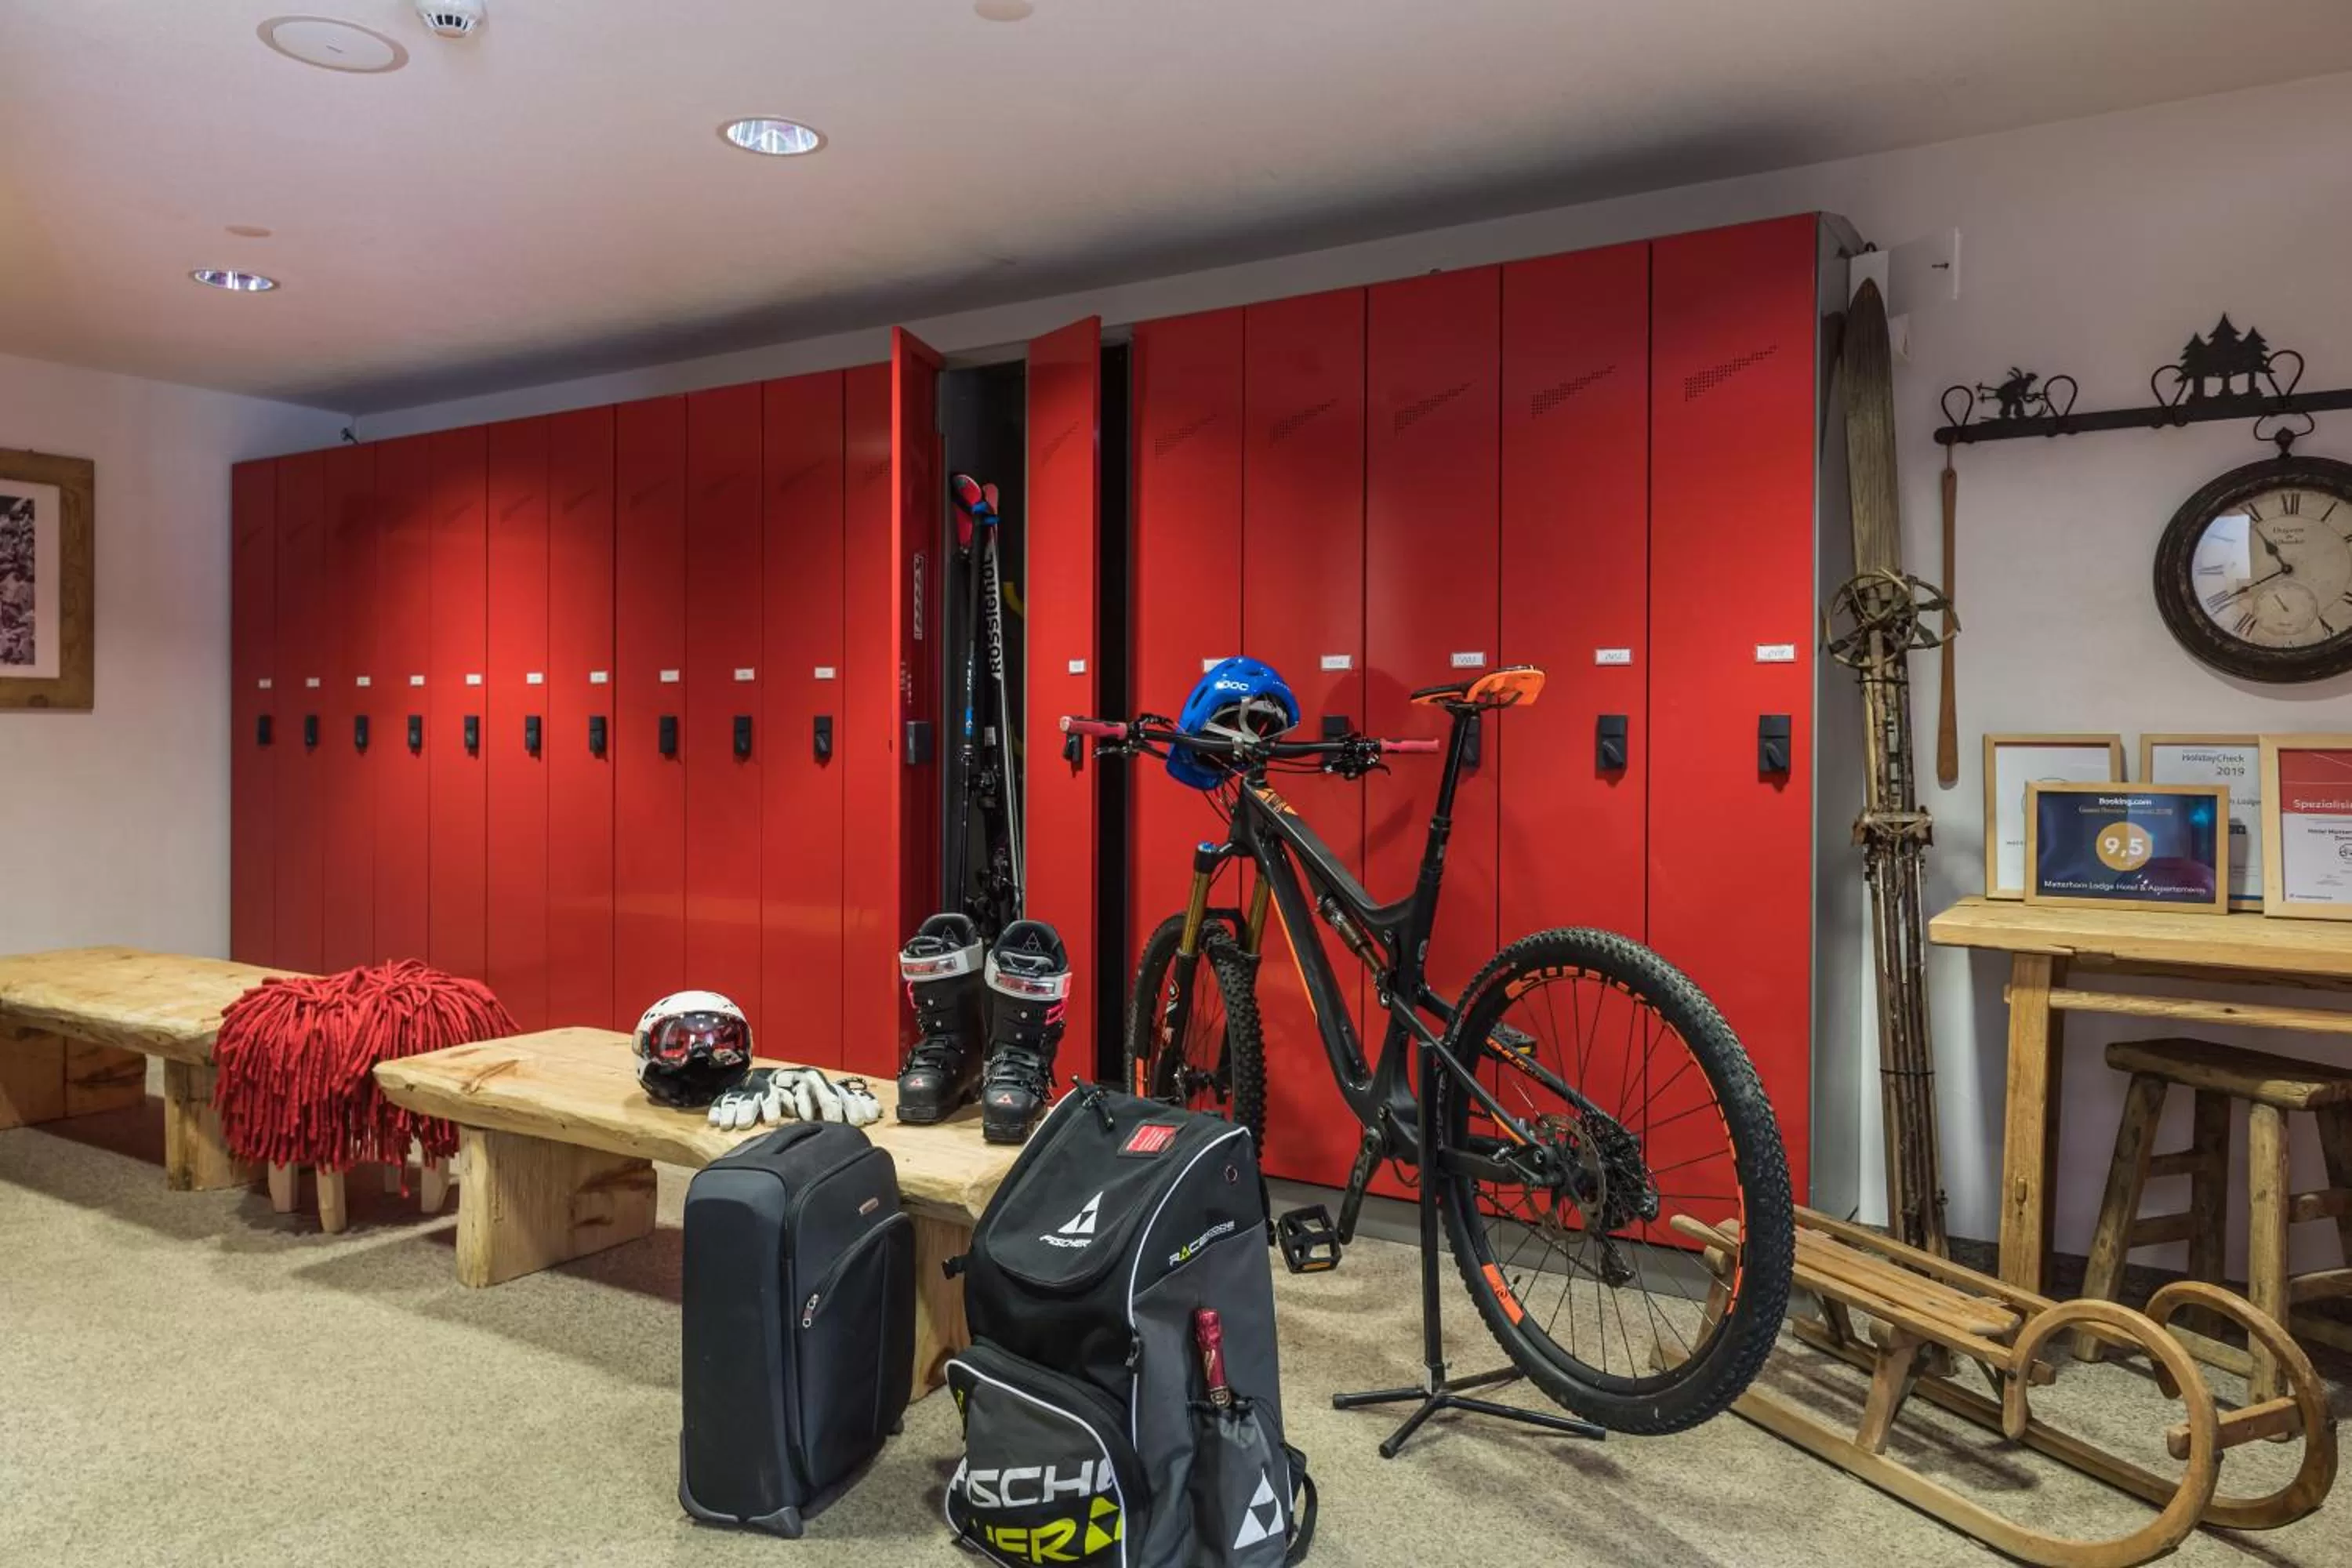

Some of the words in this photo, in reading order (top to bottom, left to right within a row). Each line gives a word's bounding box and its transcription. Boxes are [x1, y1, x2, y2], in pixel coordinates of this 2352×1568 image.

[979, 552, 1002, 674] ROSSIGNOL
[2182, 753, 2245, 764] HolidayCheck
[2216, 767, 2245, 776] 2019
[2099, 797, 2152, 807] Booking.com
[2104, 837, 2144, 858] 9,5
[2044, 880, 2088, 889] Matterhorn
[2089, 881, 2114, 892] Lodge
[2116, 883, 2138, 891] Hotel
[1039, 1234, 1092, 1248] FISCHER
